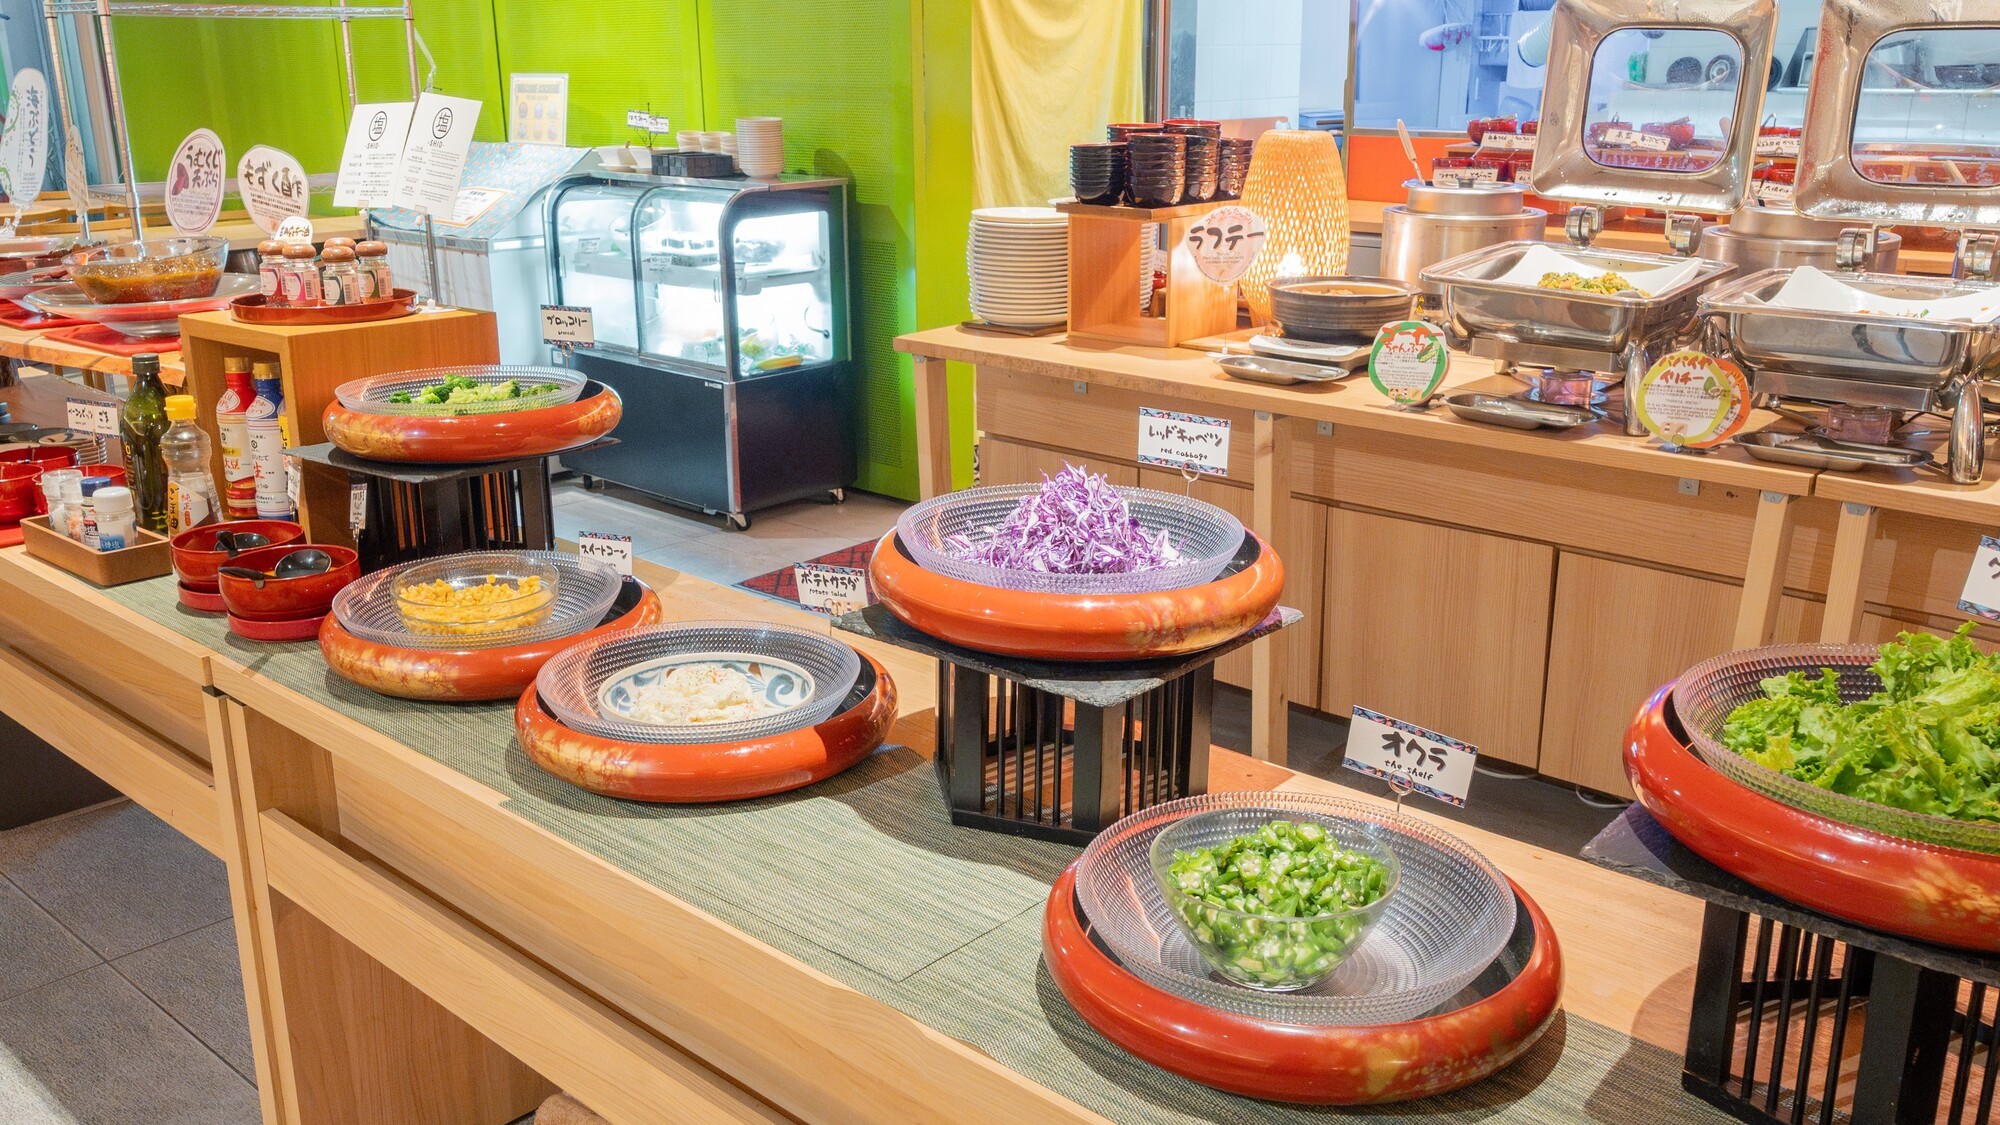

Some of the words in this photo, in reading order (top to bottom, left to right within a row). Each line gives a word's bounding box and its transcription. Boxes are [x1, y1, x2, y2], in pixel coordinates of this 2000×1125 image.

[371, 115, 386, 135] 塩
[436, 112, 451, 133] 塩
[186, 144, 223, 169] うむくじ
[191, 168, 219, 189] 天ぷら
[244, 159, 302, 198] もずく酢
[1188, 224, 1265, 251] ラフテー
[546, 314, 588, 328] ブロッコリー
[1380, 324, 1444, 346] ゴーヤー
[1658, 354, 1713, 371] パパイヤ
[1660, 369, 1705, 385] イリチー
[1148, 424, 1223, 448] レッドキャベツ
[1160, 447, 1173, 455] red
[1175, 450, 1208, 461] cabbage
[581, 542, 628, 560] スイートコーン
[801, 569, 860, 592] ポテトサラダ
[1381, 730, 1448, 772] オクラ
[1384, 759, 1403, 771] the
[1407, 766, 1434, 781] shelf
